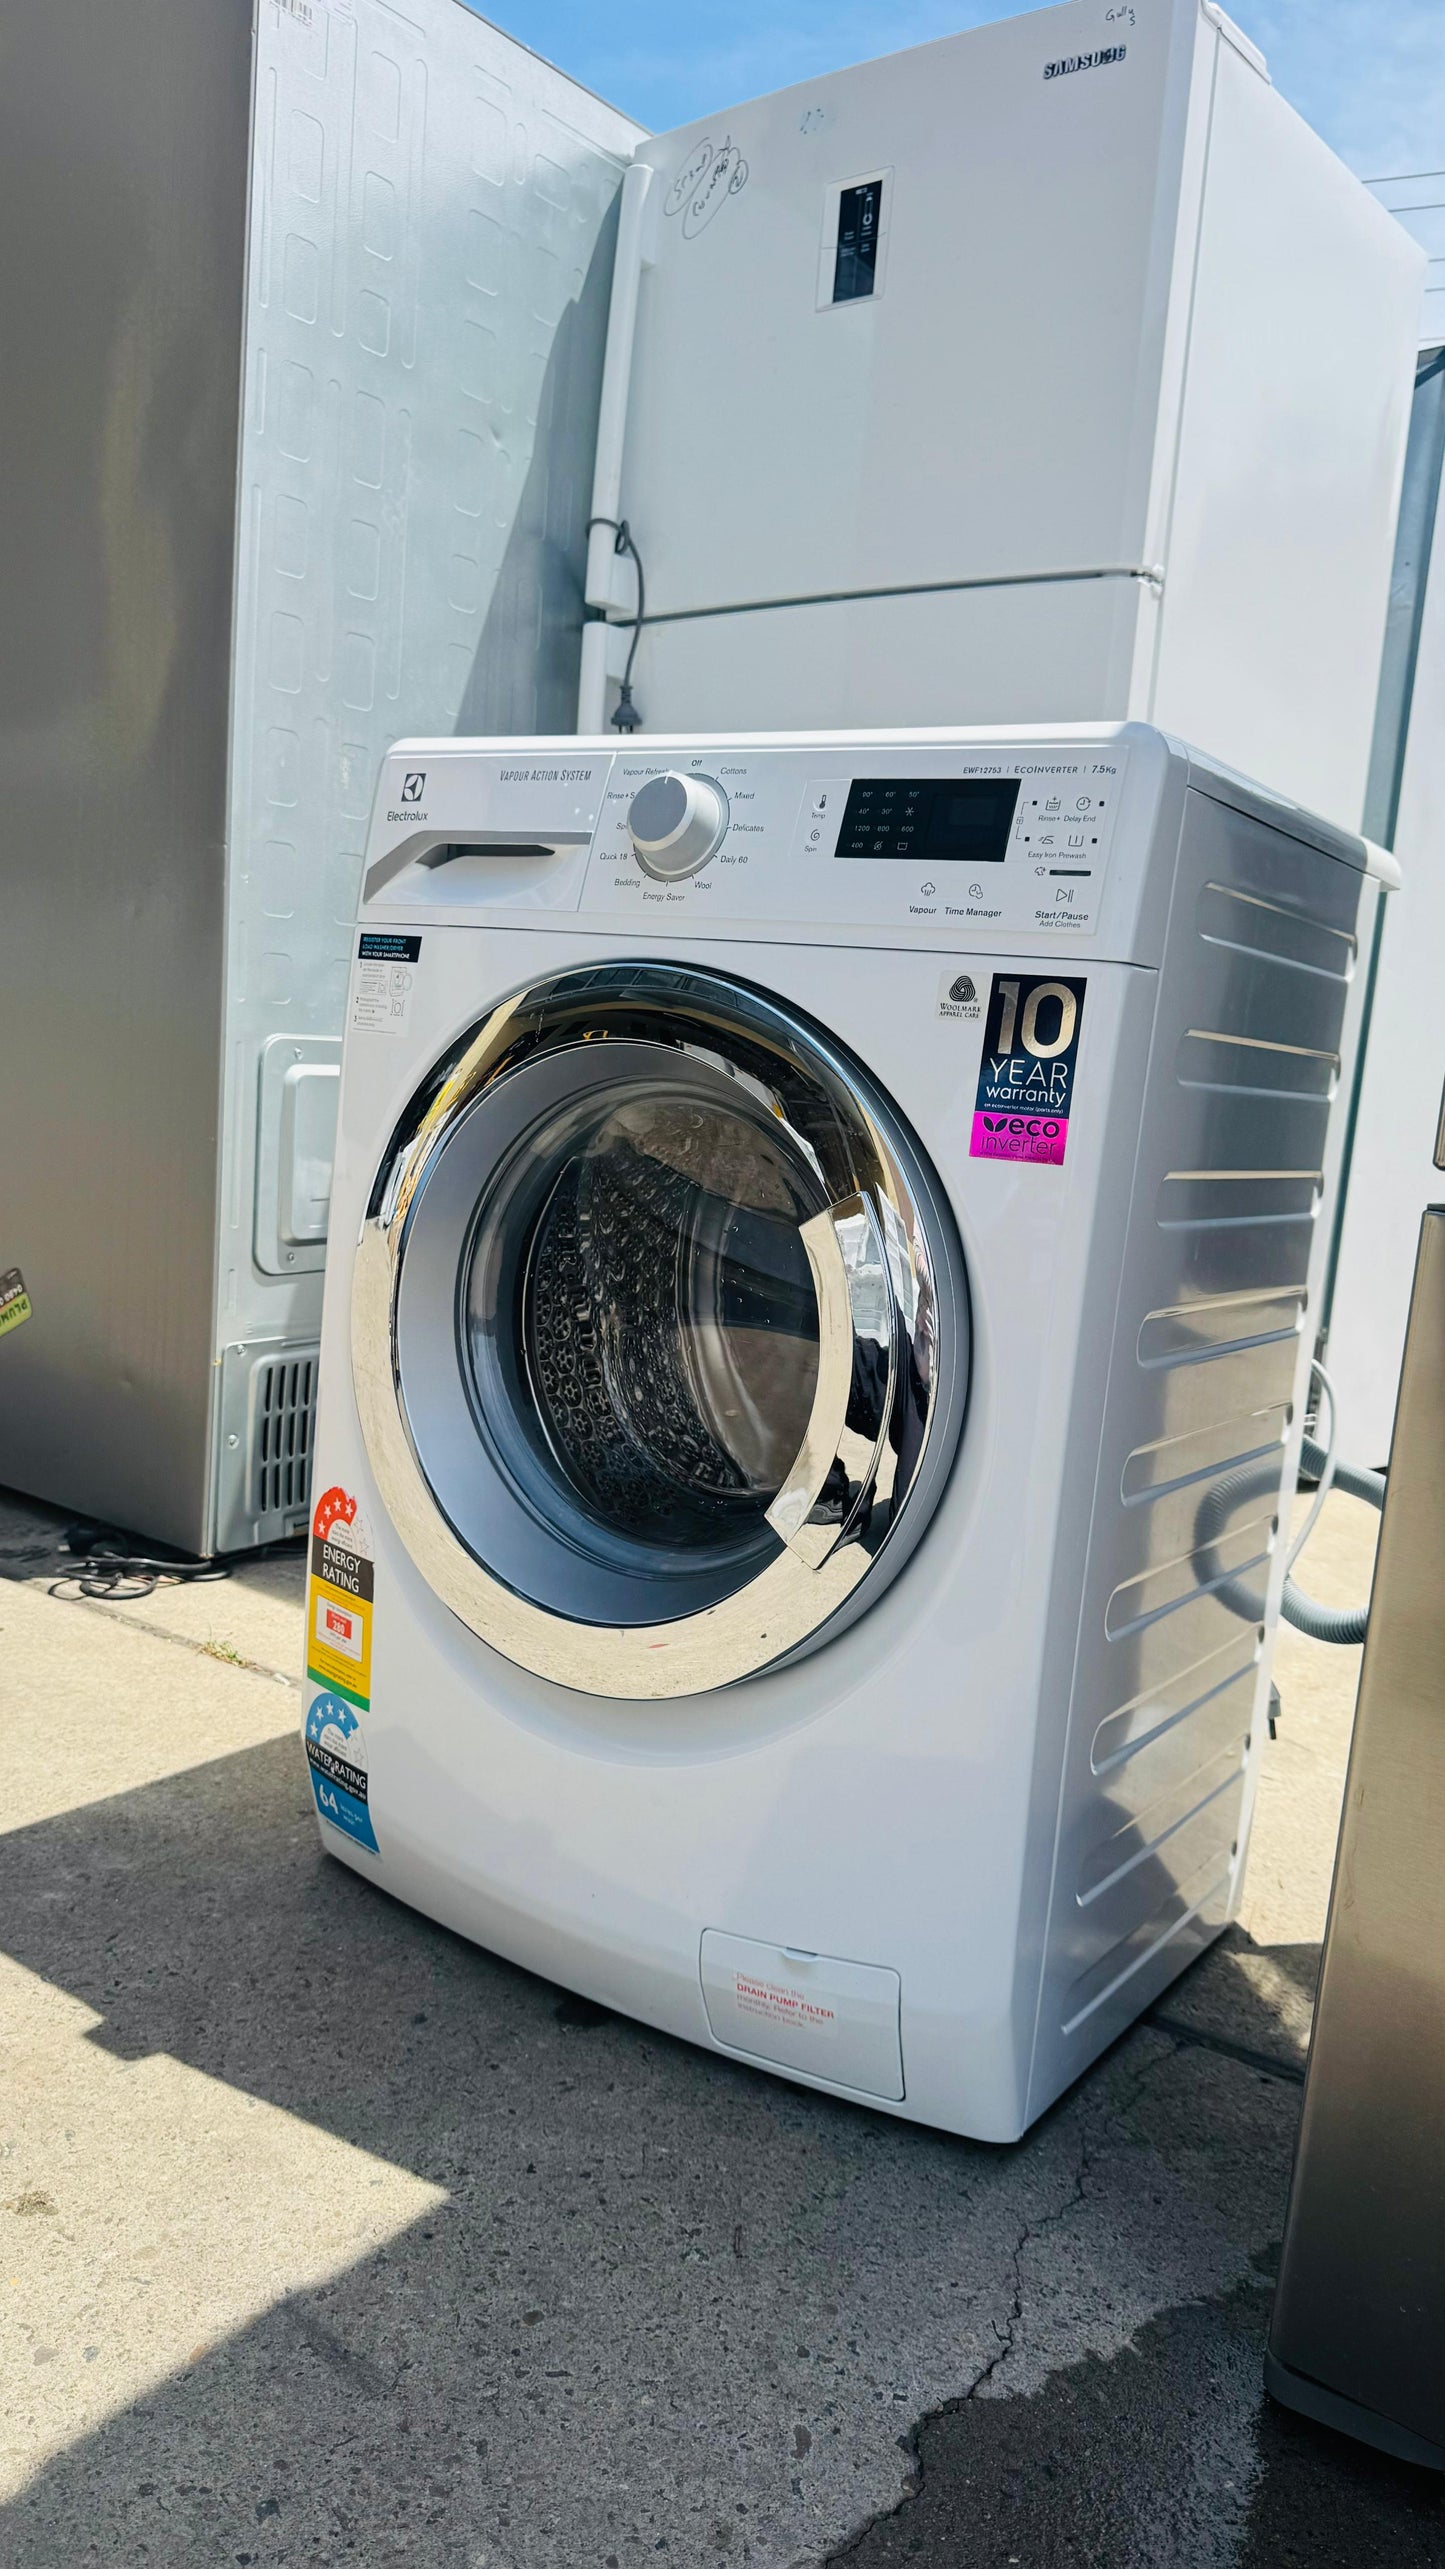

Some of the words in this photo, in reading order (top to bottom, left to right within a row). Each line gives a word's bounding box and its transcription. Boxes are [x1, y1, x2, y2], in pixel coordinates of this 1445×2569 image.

[500, 770, 529, 781] VAPOUR
[531, 769, 559, 781] ACTION
[560, 769, 592, 781] SYSTEM
[720, 767, 747, 775] Cottons
[734, 791, 755, 800] Mixed
[386, 810, 429, 822] Electrolux
[1063, 814, 1082, 824] Delay
[1083, 815, 1096, 823] End
[732, 823, 765, 833] Delicates
[599, 852, 617, 861] Quick
[720, 855, 738, 865] Daily
[738, 856, 749, 864] 60
[1058, 852, 1087, 860] Prewash
[614, 878, 641, 889] Bedding
[694, 881, 712, 889] Wool
[642, 891, 665, 902] Energy
[909, 905, 937, 915] Vapour
[945, 907, 965, 917] Time
[966, 908, 1002, 918] Manager
[1034, 911, 1089, 921] Start/Pause
[1039, 920, 1053, 928] Add
[1054, 920, 1081, 929] Clothes
[940, 1002, 981, 1013] WOOLMARK
[939, 1010, 963, 1018] APPAREL
[998, 981, 1077, 1058] 10
[989, 1057, 1069, 1089] YEAR
[986, 1086, 1067, 1108] warranty
[1008, 1118, 1060, 1139] eco
[981, 1132, 1057, 1157] inverter
[323, 1543, 361, 1574] ENERGY
[322, 1562, 360, 1593] RATING
[334, 1758, 367, 1789] RATING
[319, 1783, 339, 1815] 64
[736, 1982, 767, 2000] DRAIN
[769, 1993, 799, 2009] PUMP
[801, 2002, 835, 2020] FILTER
